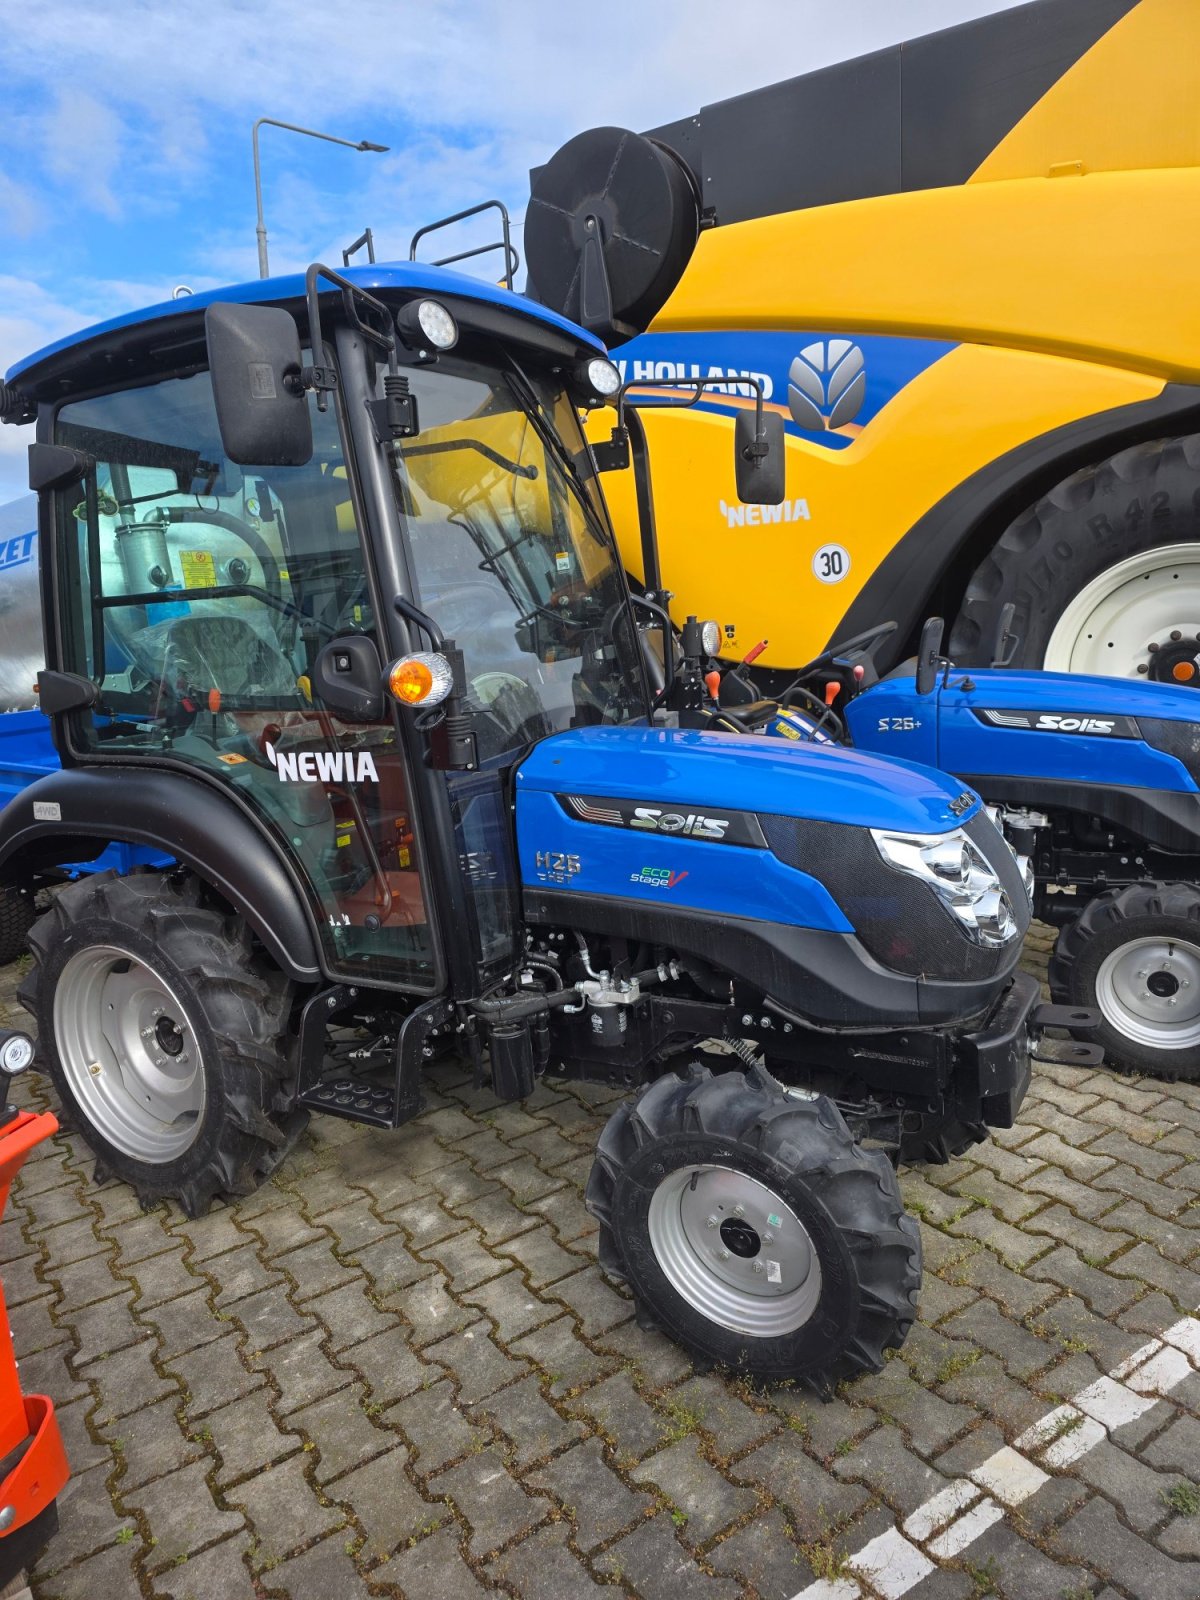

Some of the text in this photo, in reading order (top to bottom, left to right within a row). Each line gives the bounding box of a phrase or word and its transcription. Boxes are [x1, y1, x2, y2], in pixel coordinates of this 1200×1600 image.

[633, 360, 774, 401] HOLLAND
[727, 498, 811, 528] NEWIA
[820, 550, 843, 577] 30
[276, 751, 380, 782] NEWIA
